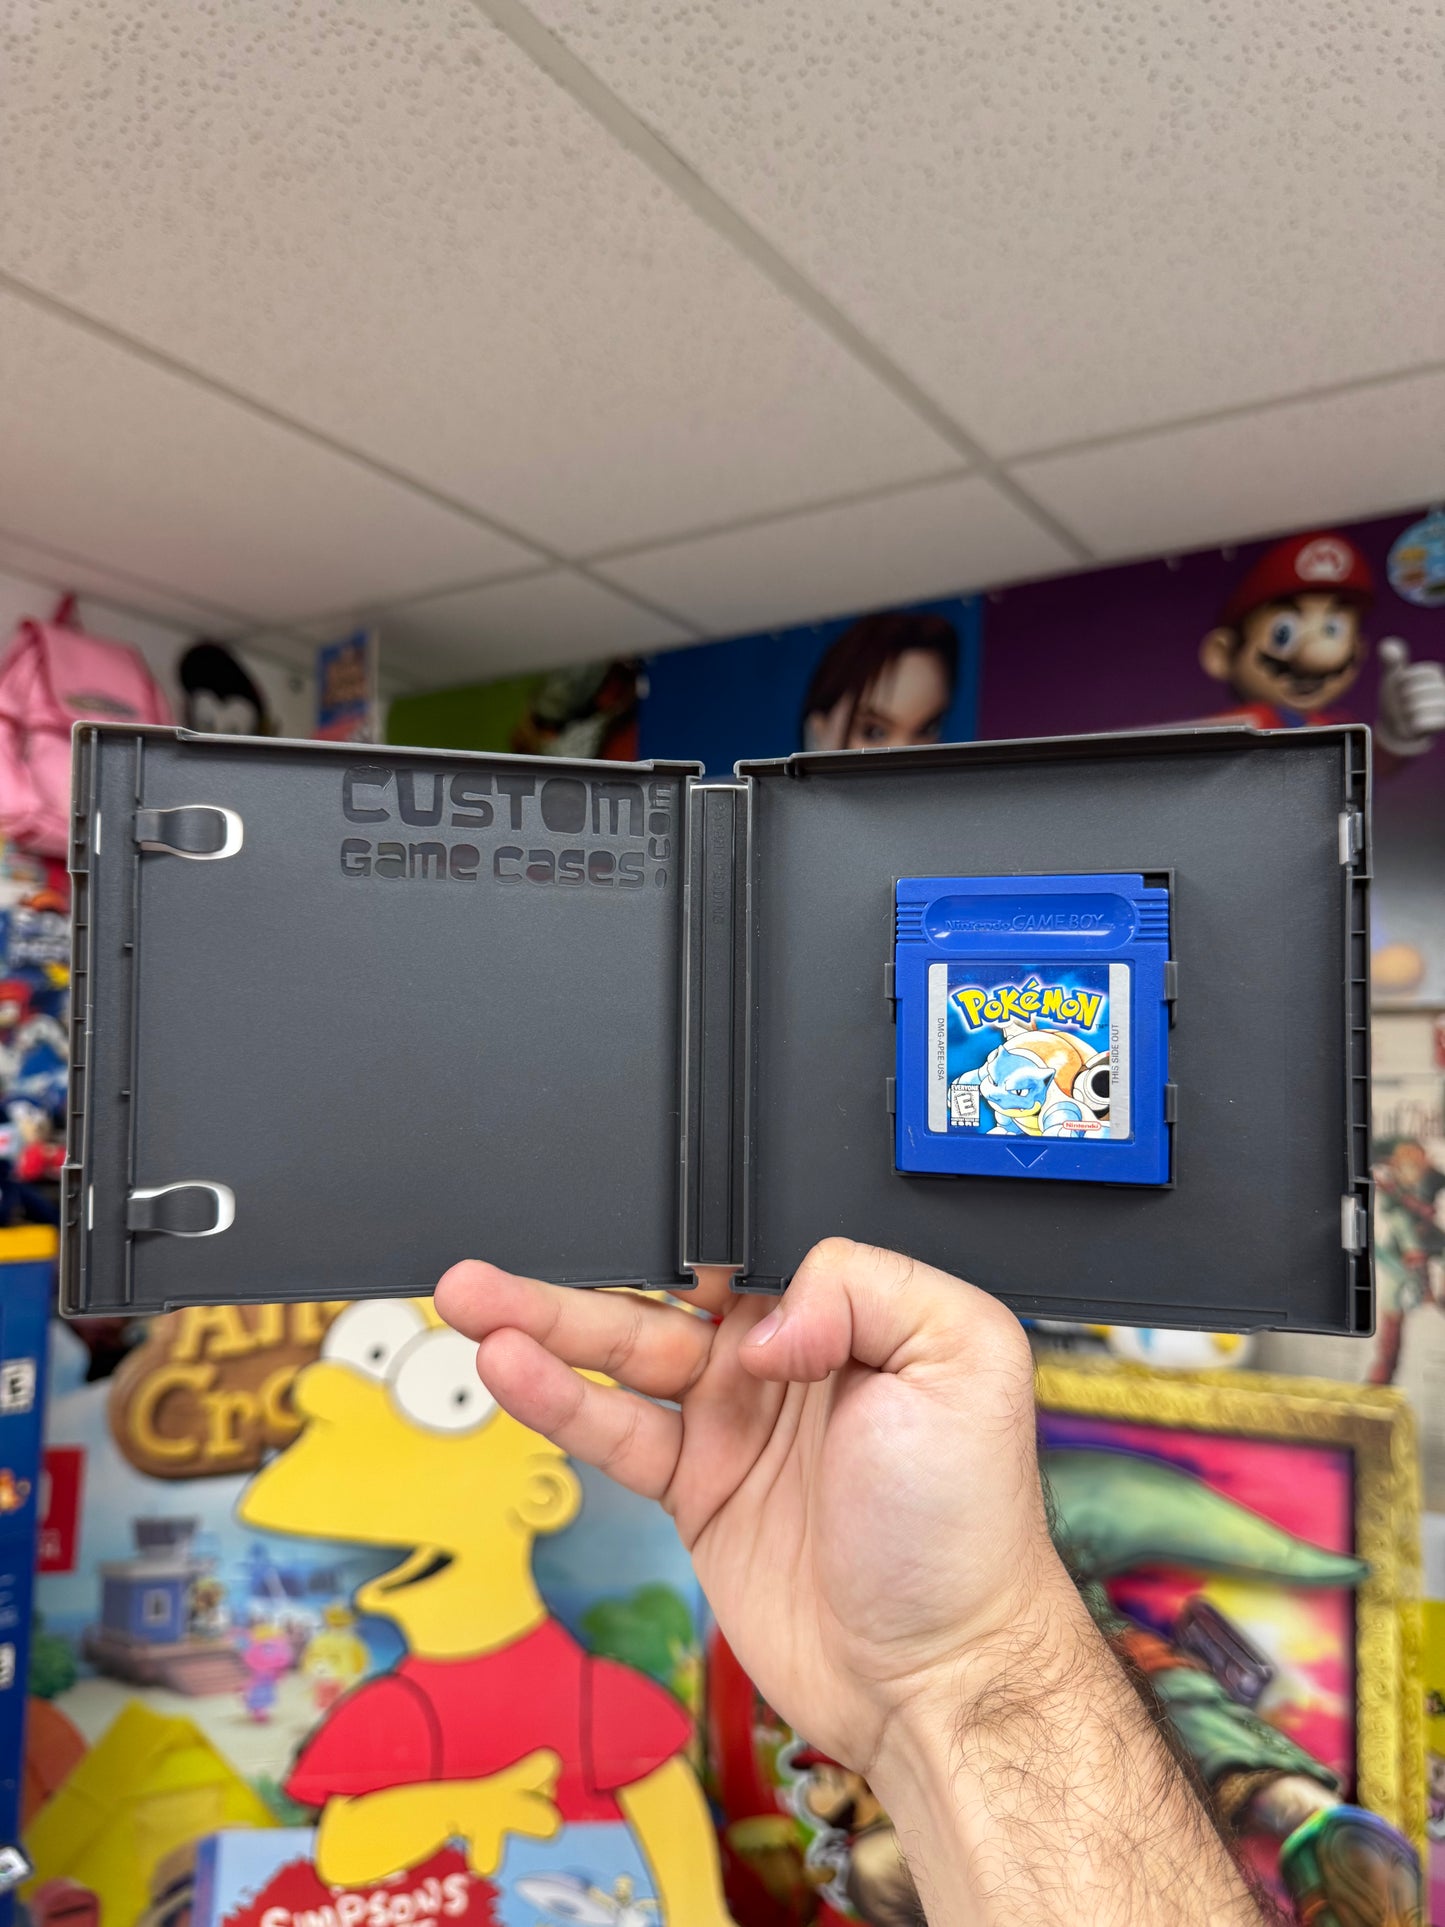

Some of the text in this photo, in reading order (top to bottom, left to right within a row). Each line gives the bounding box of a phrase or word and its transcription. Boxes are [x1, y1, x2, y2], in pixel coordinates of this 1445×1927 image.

[1012, 914, 1066, 930] GAME
[1069, 913, 1105, 929] BOY
[1111, 1024, 1119, 1085] THIS SIDE OUT
[956, 1094, 976, 1116] E
